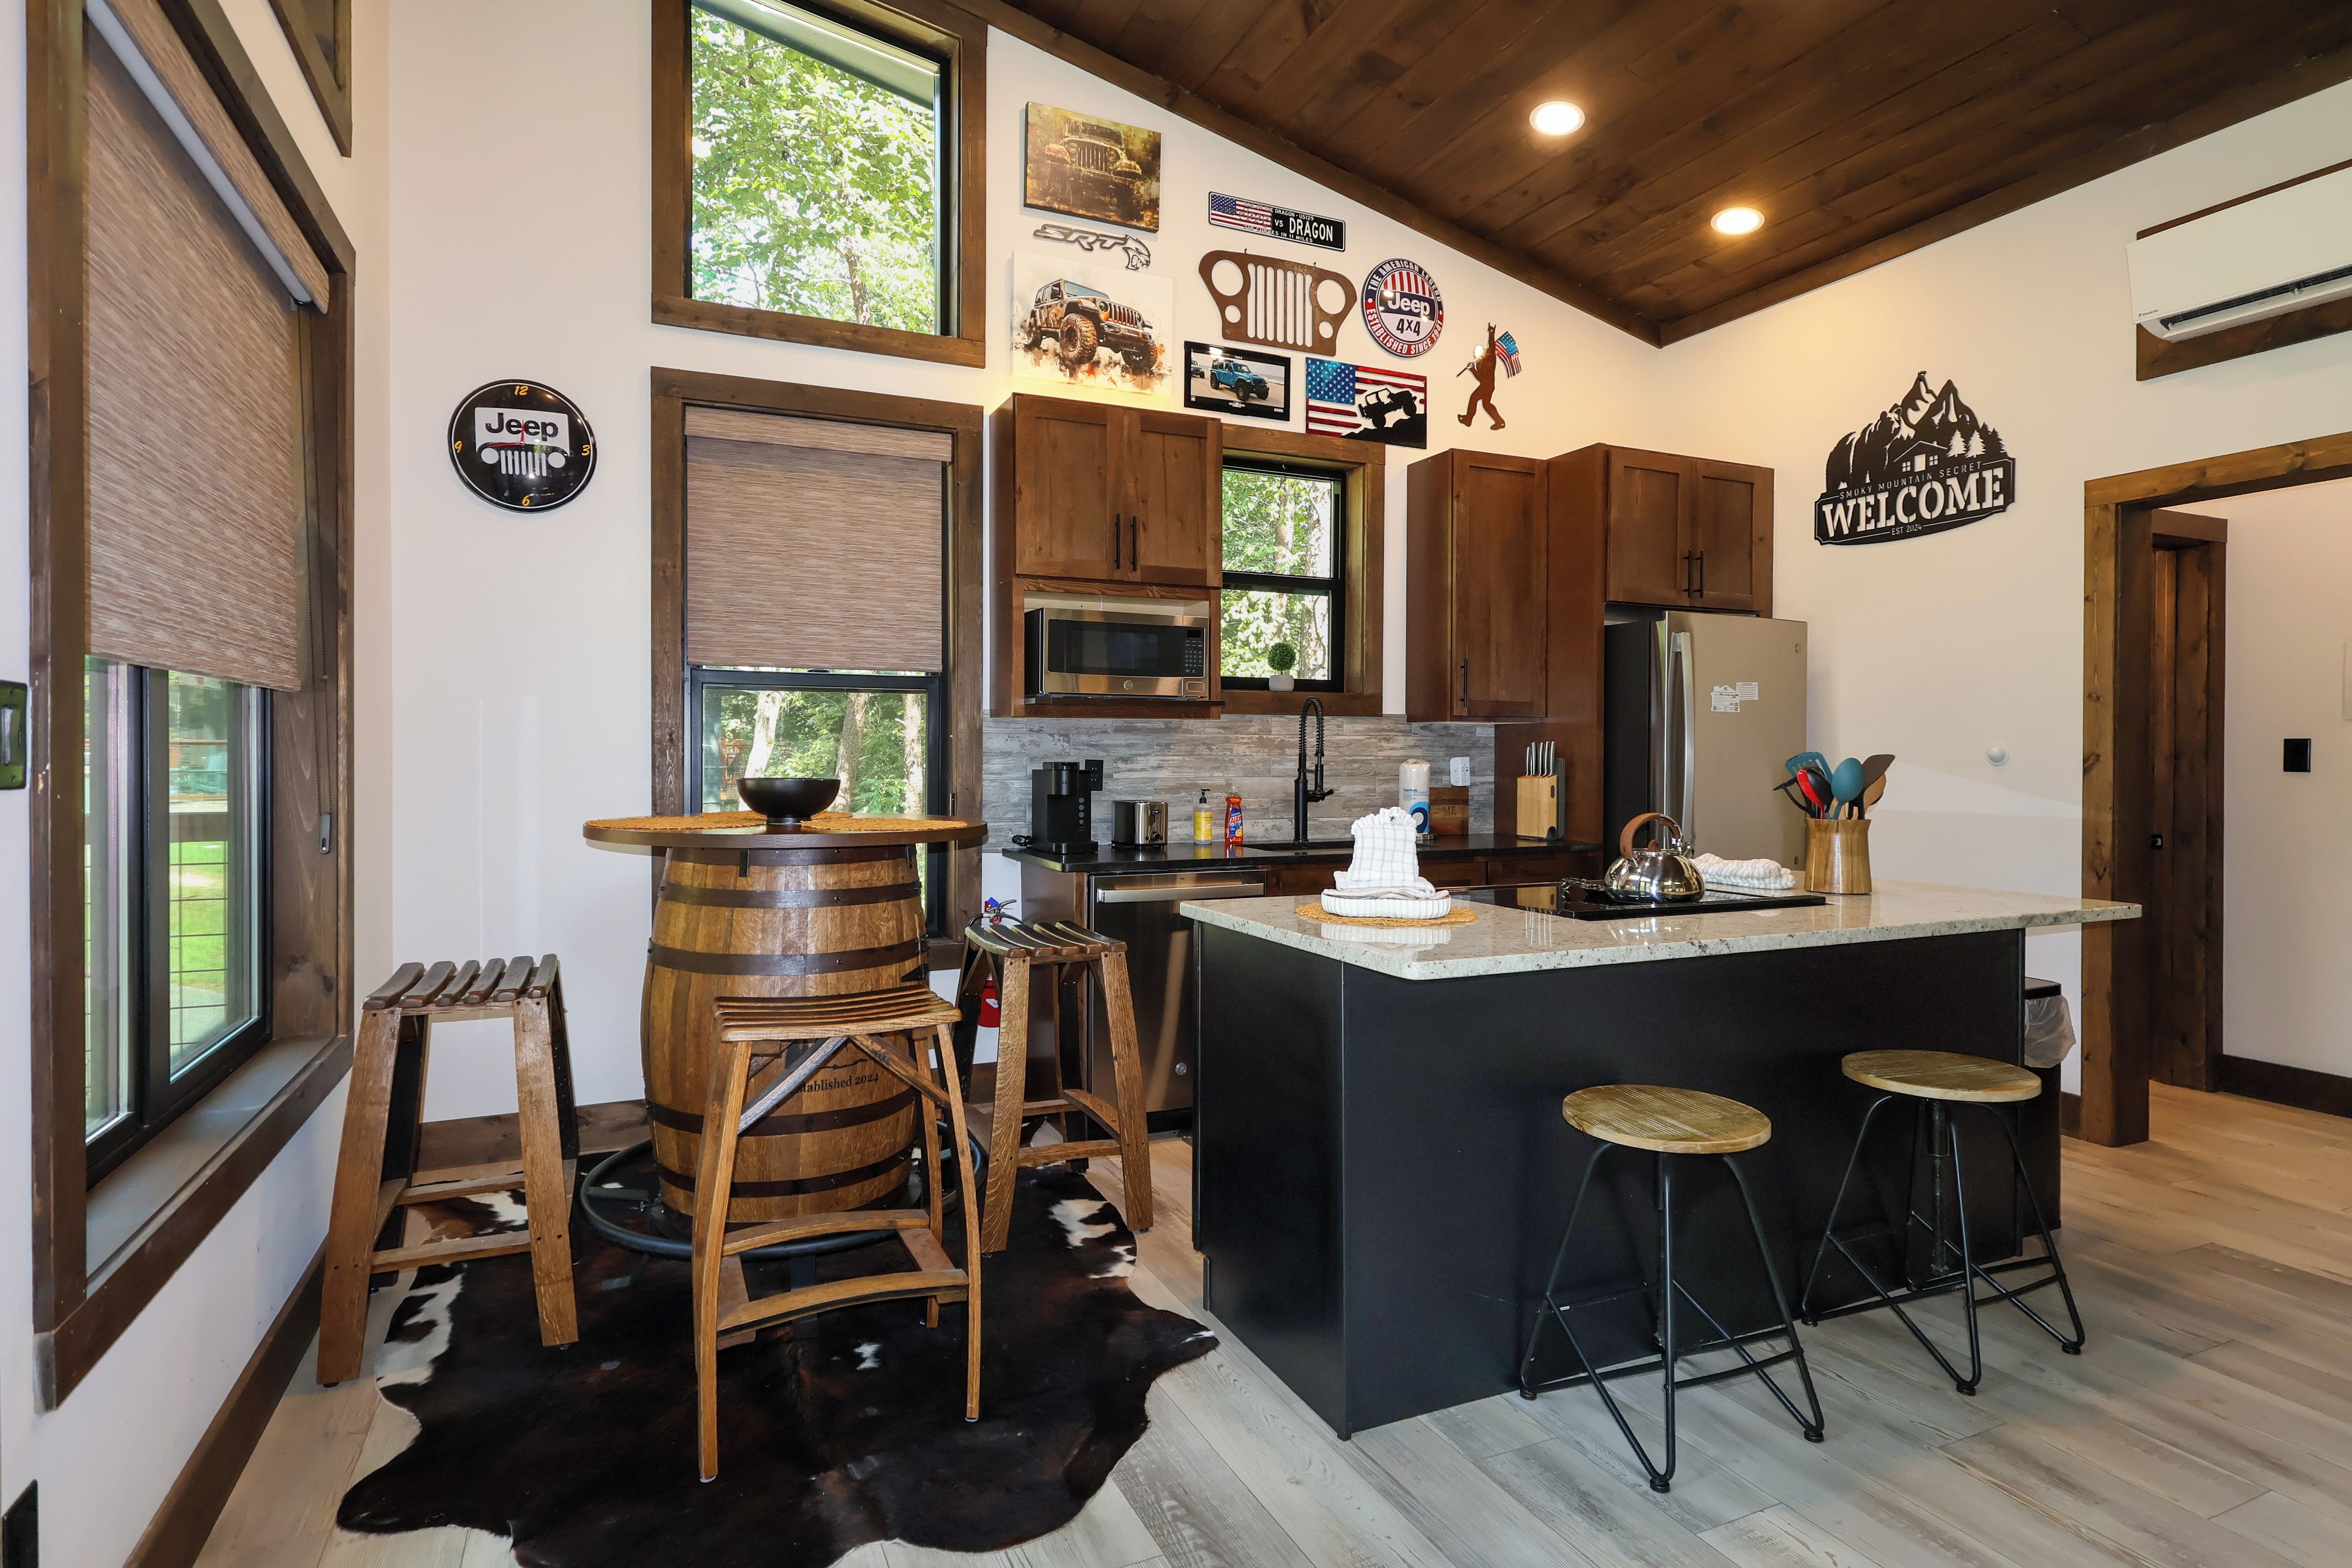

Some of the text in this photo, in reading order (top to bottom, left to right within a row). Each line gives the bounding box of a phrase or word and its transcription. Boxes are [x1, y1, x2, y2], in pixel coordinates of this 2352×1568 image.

[1275, 209, 1295, 217] DRAGON
[1238, 207, 1333, 242] Jeep VS DRAGON
[1256, 227, 1279, 236] CURVES
[1033, 224, 1128, 251] SRT
[1368, 260, 1442, 302] THE AMERICAN LEGEND
[1387, 292, 1430, 317] Jeep
[1366, 308, 1442, 355] ESTABLISHED SINCE 1941
[514, 385, 529, 396] 12
[484, 412, 559, 442] Jeep
[454, 440, 462, 454] 9
[581, 445, 591, 456] 3
[1839, 461, 1982, 499] SMOKY MOUNTAIN SECRET
[522, 495, 530, 507] 6
[1822, 467, 2004, 538] WELCOME
[1891, 524, 1922, 535] EST 2024
[1231, 815, 1242, 824] AJAX
[797, 1072, 879, 1093] stablished 2024
